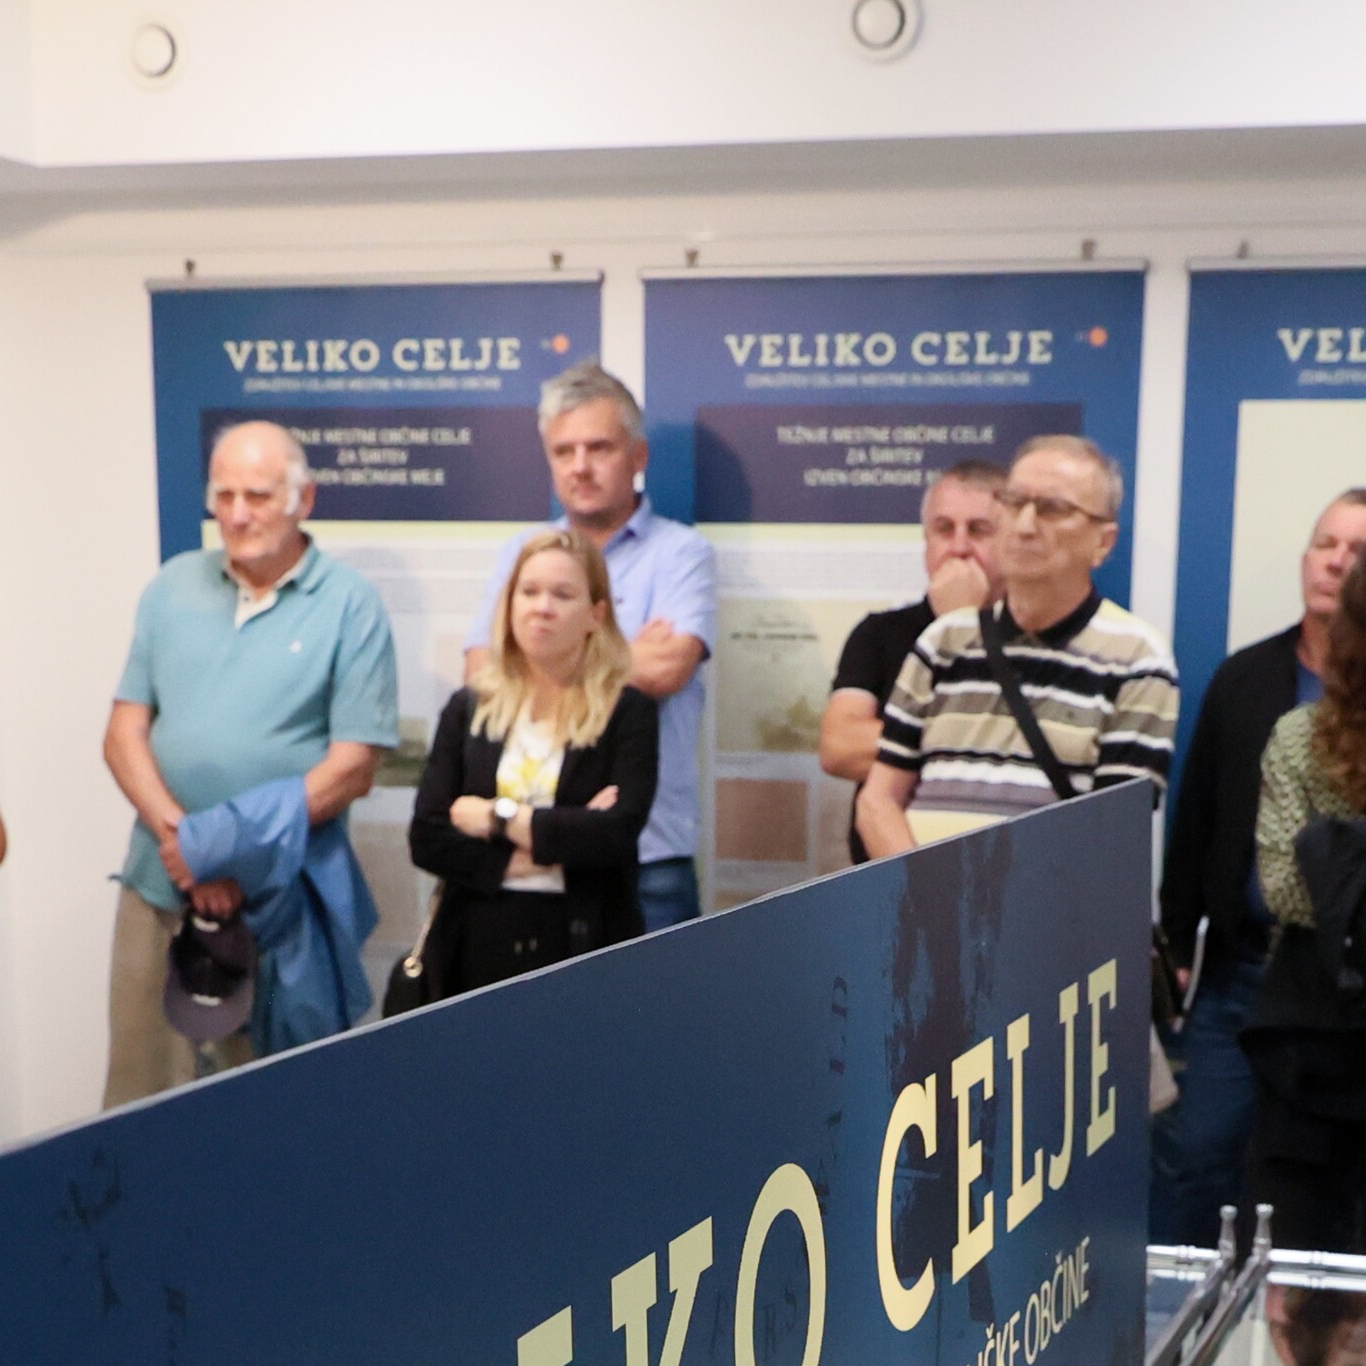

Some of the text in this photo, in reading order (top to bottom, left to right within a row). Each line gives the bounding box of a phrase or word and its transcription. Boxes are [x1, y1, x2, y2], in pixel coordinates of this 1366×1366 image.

[224, 337, 521, 372] VELIKO CELJE
[725, 331, 1054, 367] VELIKO CELJE
[875, 959, 1118, 1332] CELJE
[1023, 1236, 1091, 1366] OBČINE
